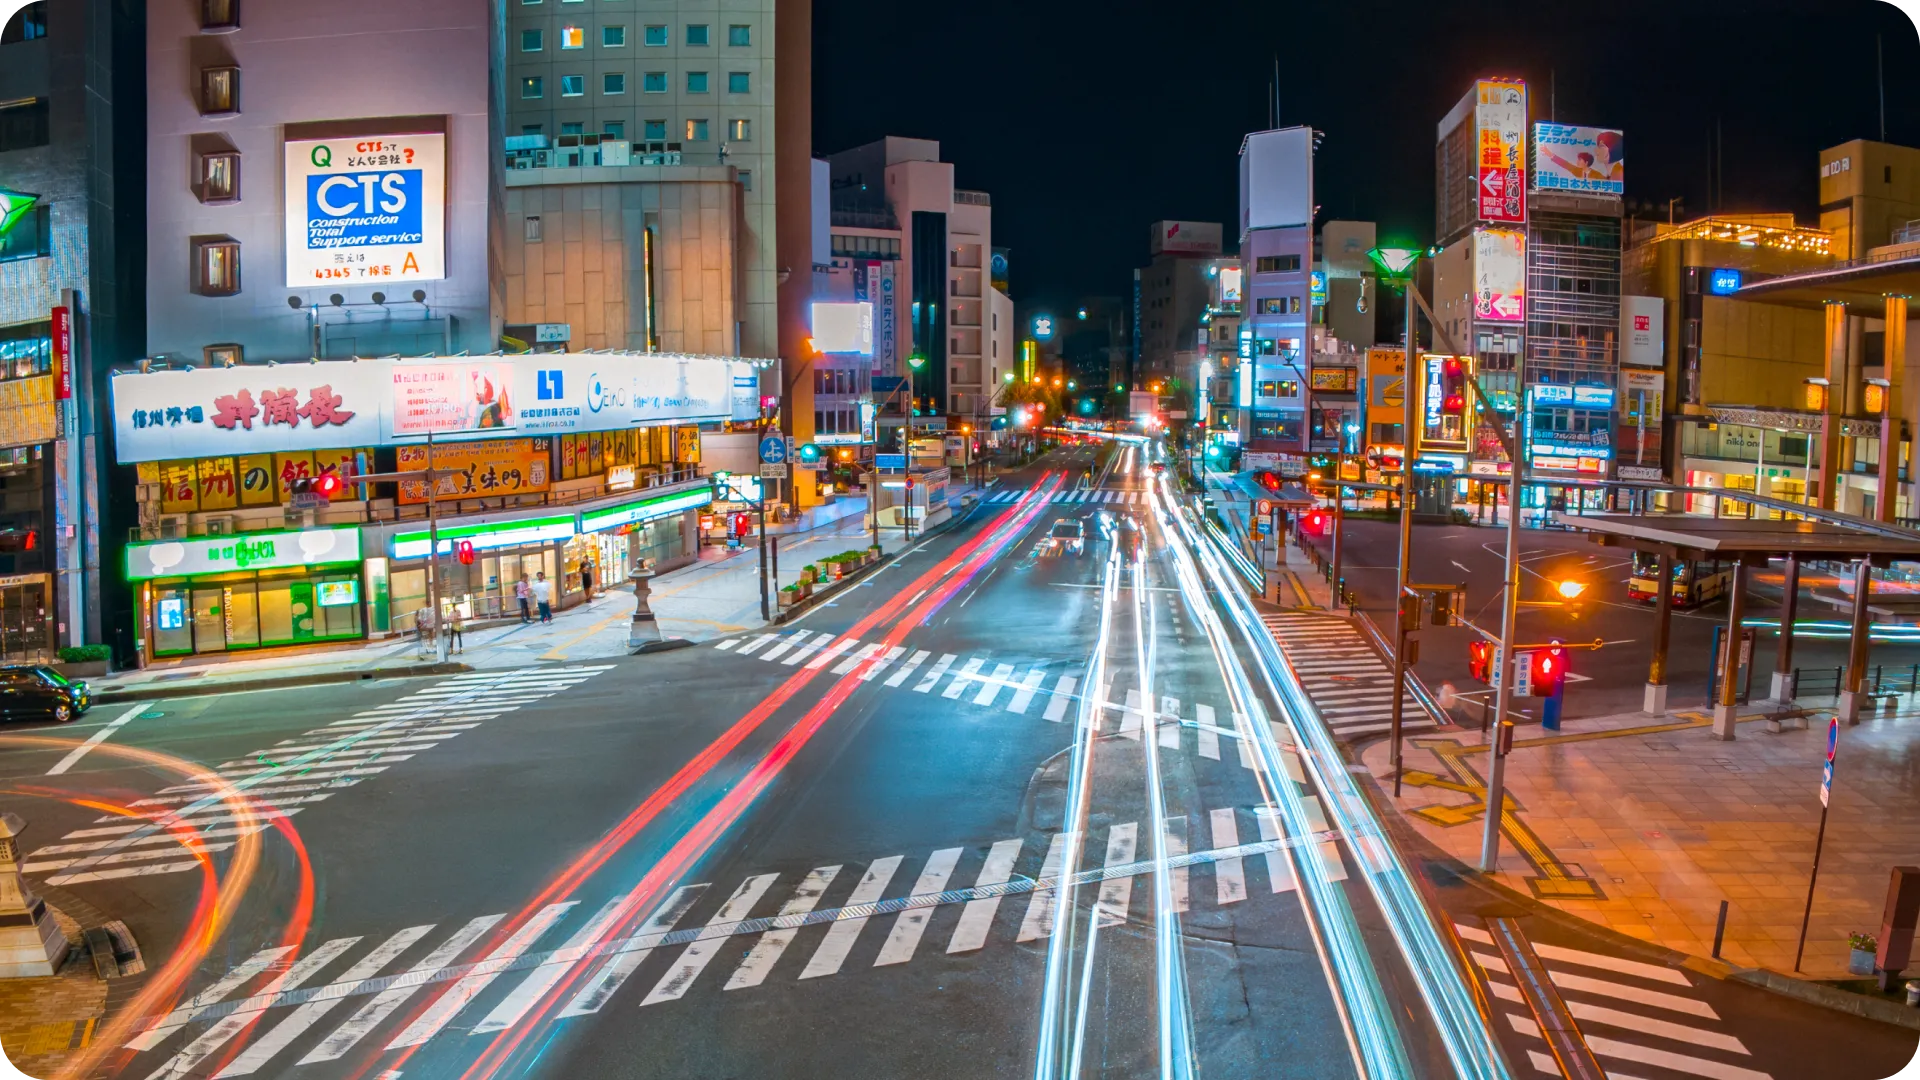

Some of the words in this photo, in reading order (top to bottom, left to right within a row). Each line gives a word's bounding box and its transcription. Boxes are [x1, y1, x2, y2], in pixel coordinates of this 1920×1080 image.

[1538, 125, 1577, 137] ミライ
[311, 145, 332, 167] Q
[1537, 176, 1623, 193] 長野日本大学学園
[316, 172, 407, 217] CTS
[309, 214, 399, 228] Construction
[309, 226, 345, 237] Total
[309, 235, 367, 249] Support
[369, 231, 422, 245] service
[402, 251, 420, 274] A
[883, 295, 893, 359] 石井スポーツ
[1374, 353, 1406, 362] ベトナ
